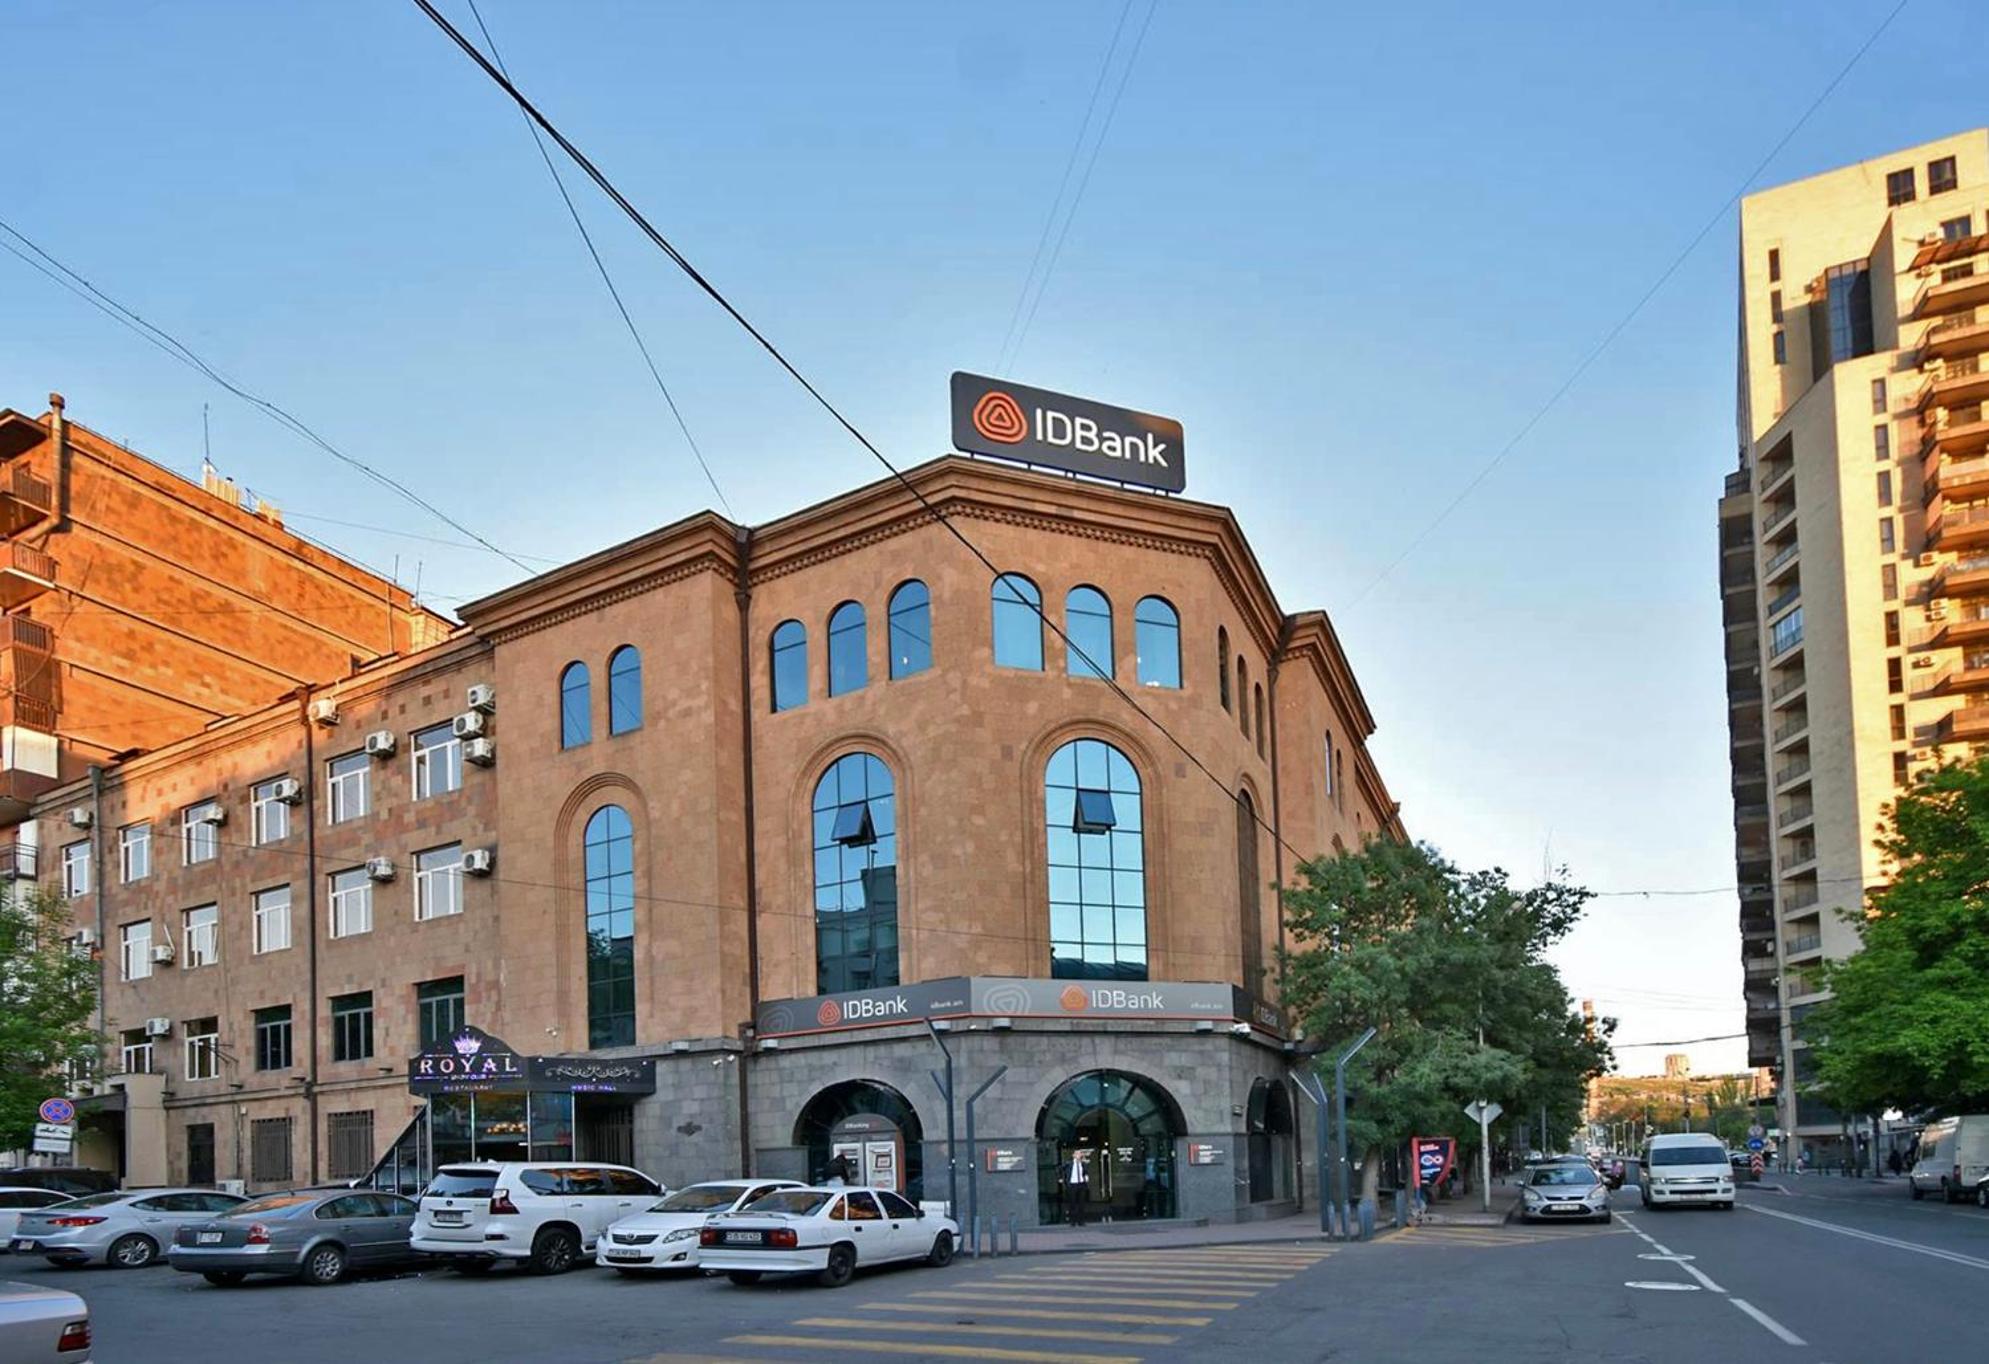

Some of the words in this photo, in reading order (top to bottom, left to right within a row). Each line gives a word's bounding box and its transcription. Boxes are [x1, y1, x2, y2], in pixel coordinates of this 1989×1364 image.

[1035, 408, 1169, 467] IDBank
[842, 995, 909, 1019] IDBank
[1092, 990, 1164, 1009] IDBank
[420, 1056, 518, 1074] ROYAL
